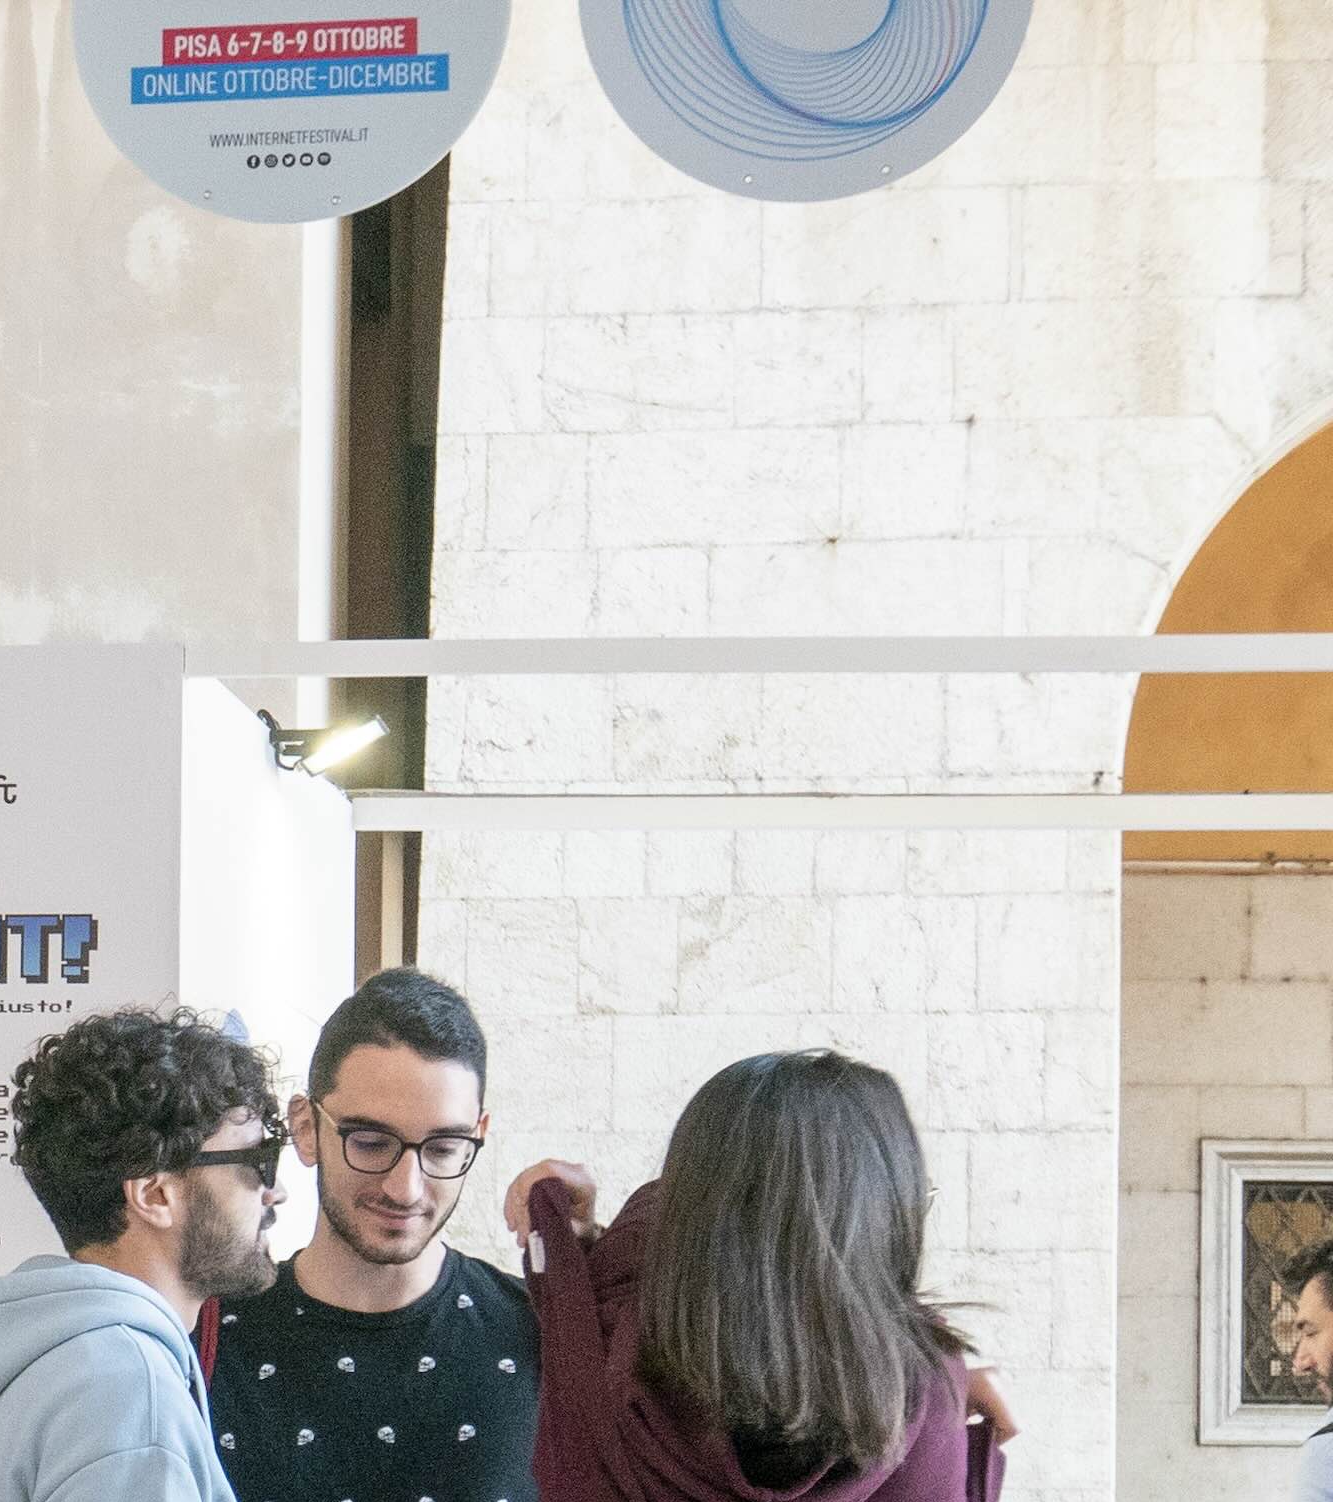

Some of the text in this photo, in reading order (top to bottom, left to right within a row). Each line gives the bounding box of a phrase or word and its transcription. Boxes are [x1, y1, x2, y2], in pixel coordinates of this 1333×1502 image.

[174, 25, 405, 58] PISA 6-7-8-9 OTTOBRE
[142, 61, 436, 97] ONLINE OTTOBRE-DICEMBRE
[210, 127, 369, 148] WWW.INTERNETFESTIVAL.IT
